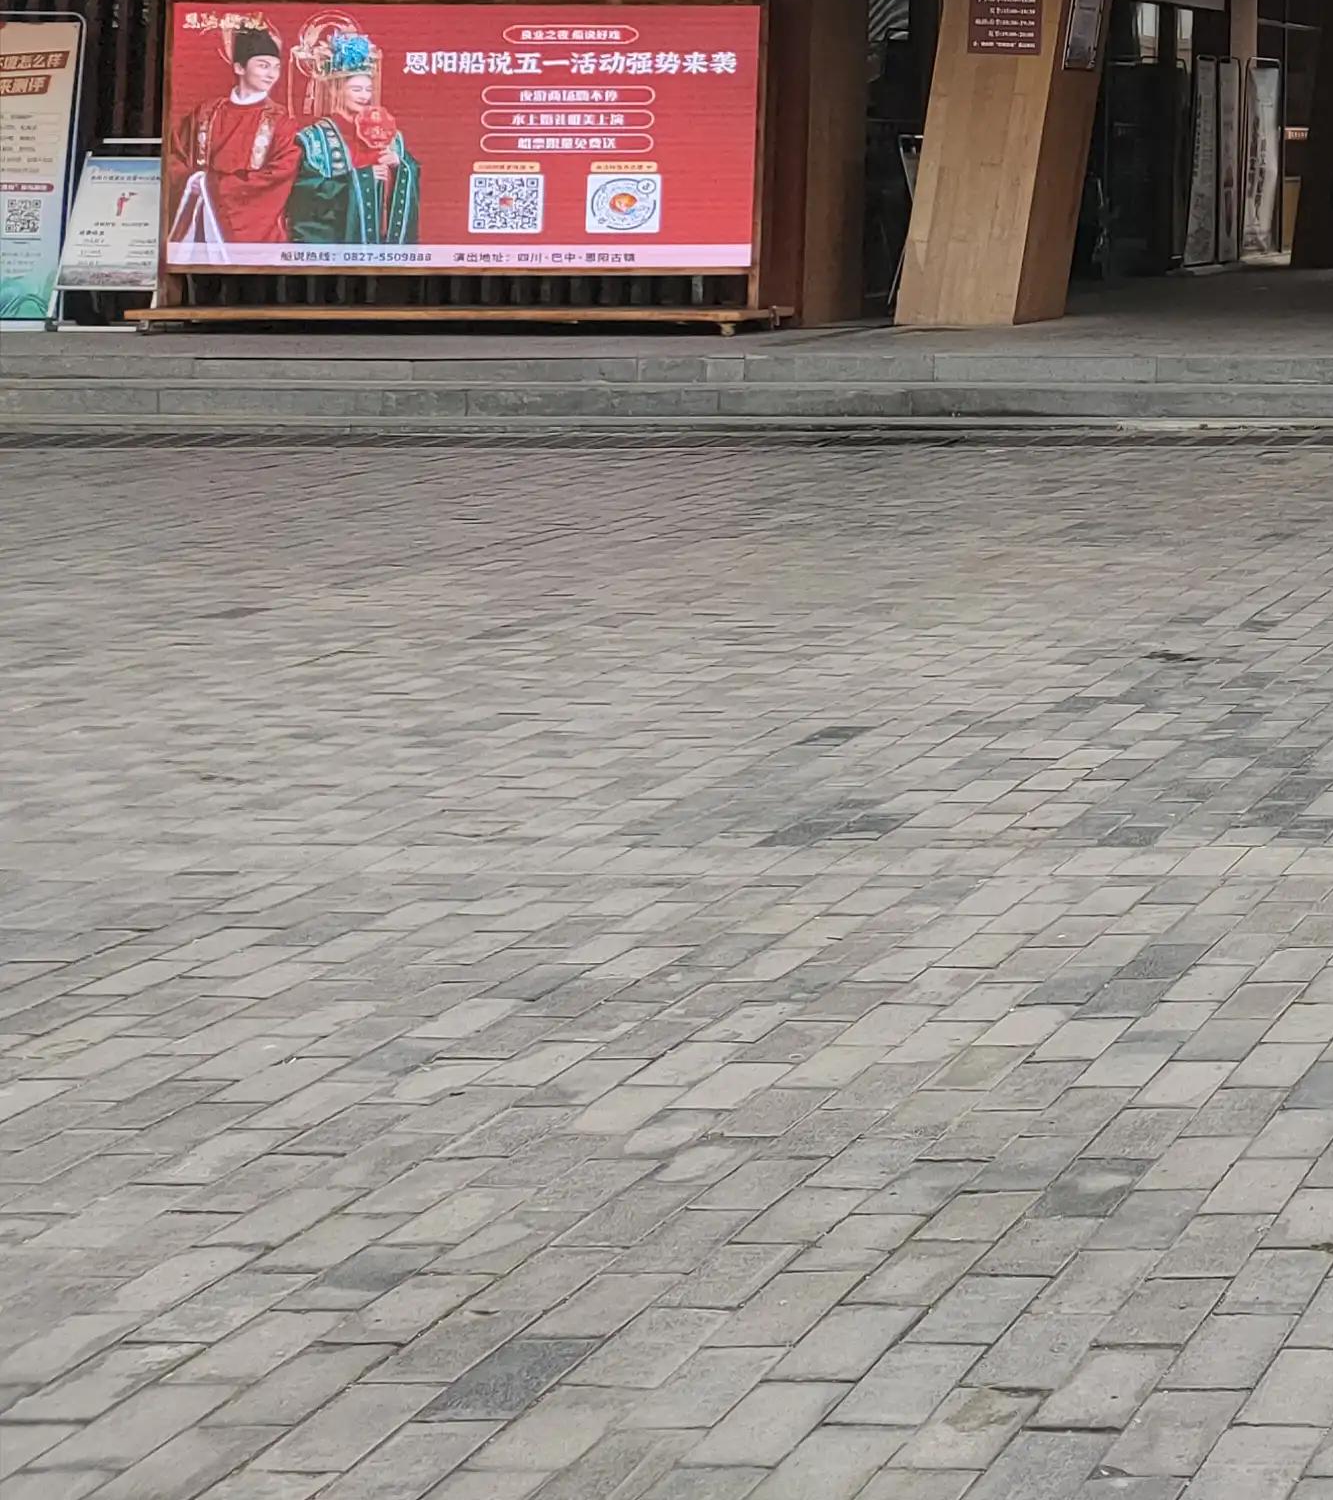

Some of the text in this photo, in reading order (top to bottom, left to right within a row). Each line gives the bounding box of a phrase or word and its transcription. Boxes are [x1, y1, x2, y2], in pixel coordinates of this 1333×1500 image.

[403, 50, 738, 76] 恩阳船说五一活动强势来袭
